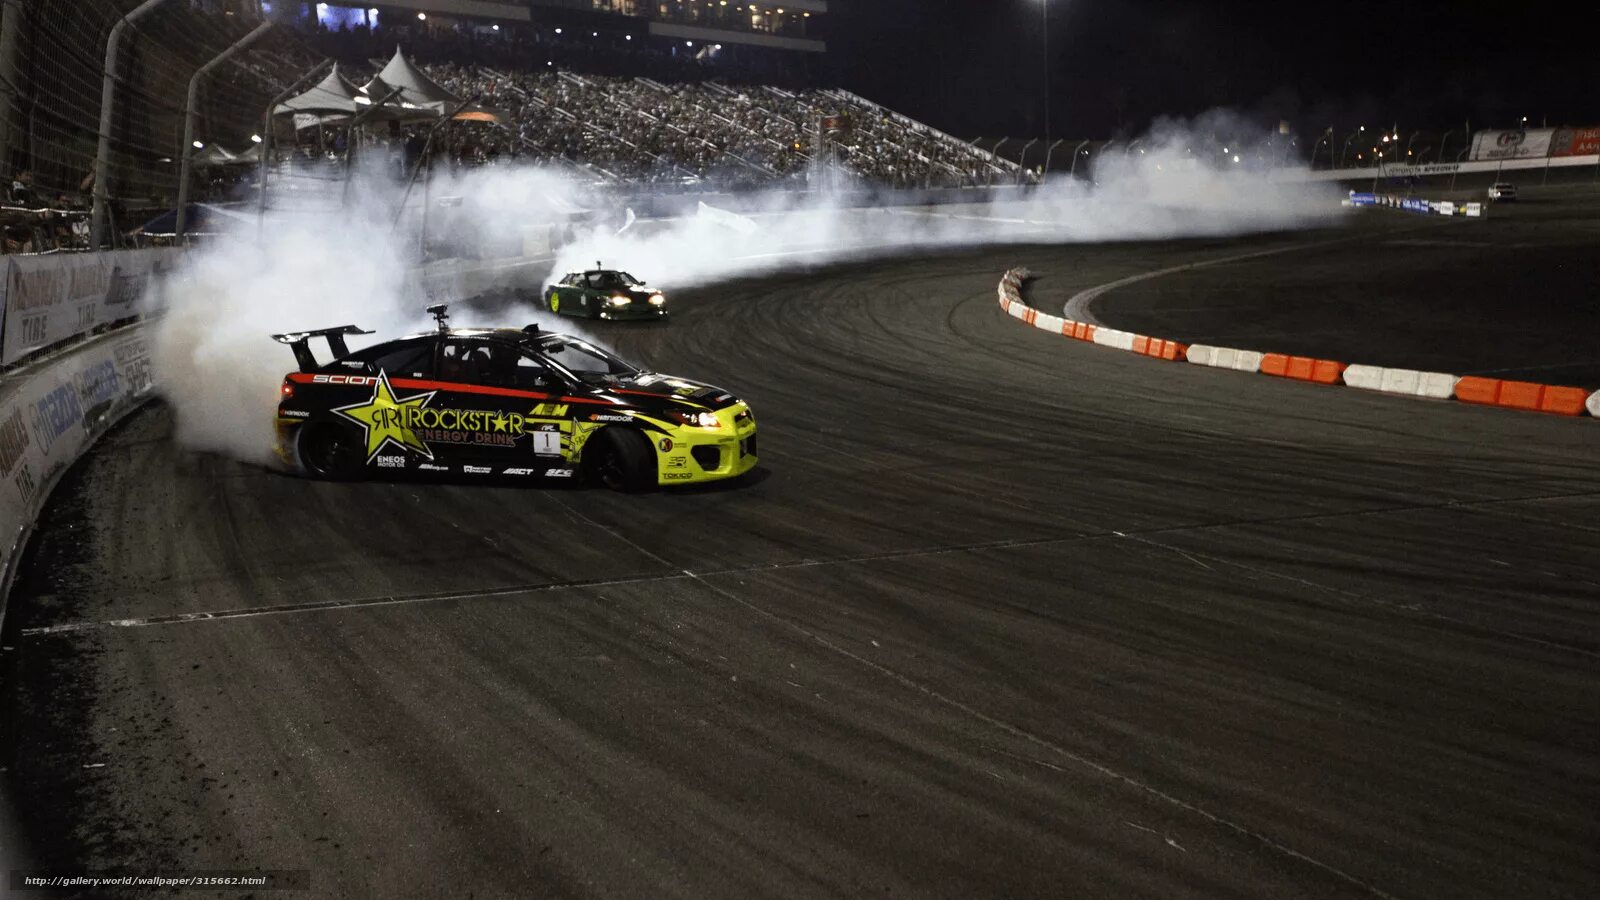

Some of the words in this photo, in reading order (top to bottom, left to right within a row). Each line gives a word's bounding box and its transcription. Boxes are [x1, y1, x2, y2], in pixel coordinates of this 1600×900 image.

[77, 303, 96, 327] TIRE
[22, 315, 48, 344] TIRE
[529, 403, 569, 416] AEM
[416, 429, 470, 443] ENERGY
[474, 433, 515, 445] DRINK
[377, 456, 405, 464] ENEOS
